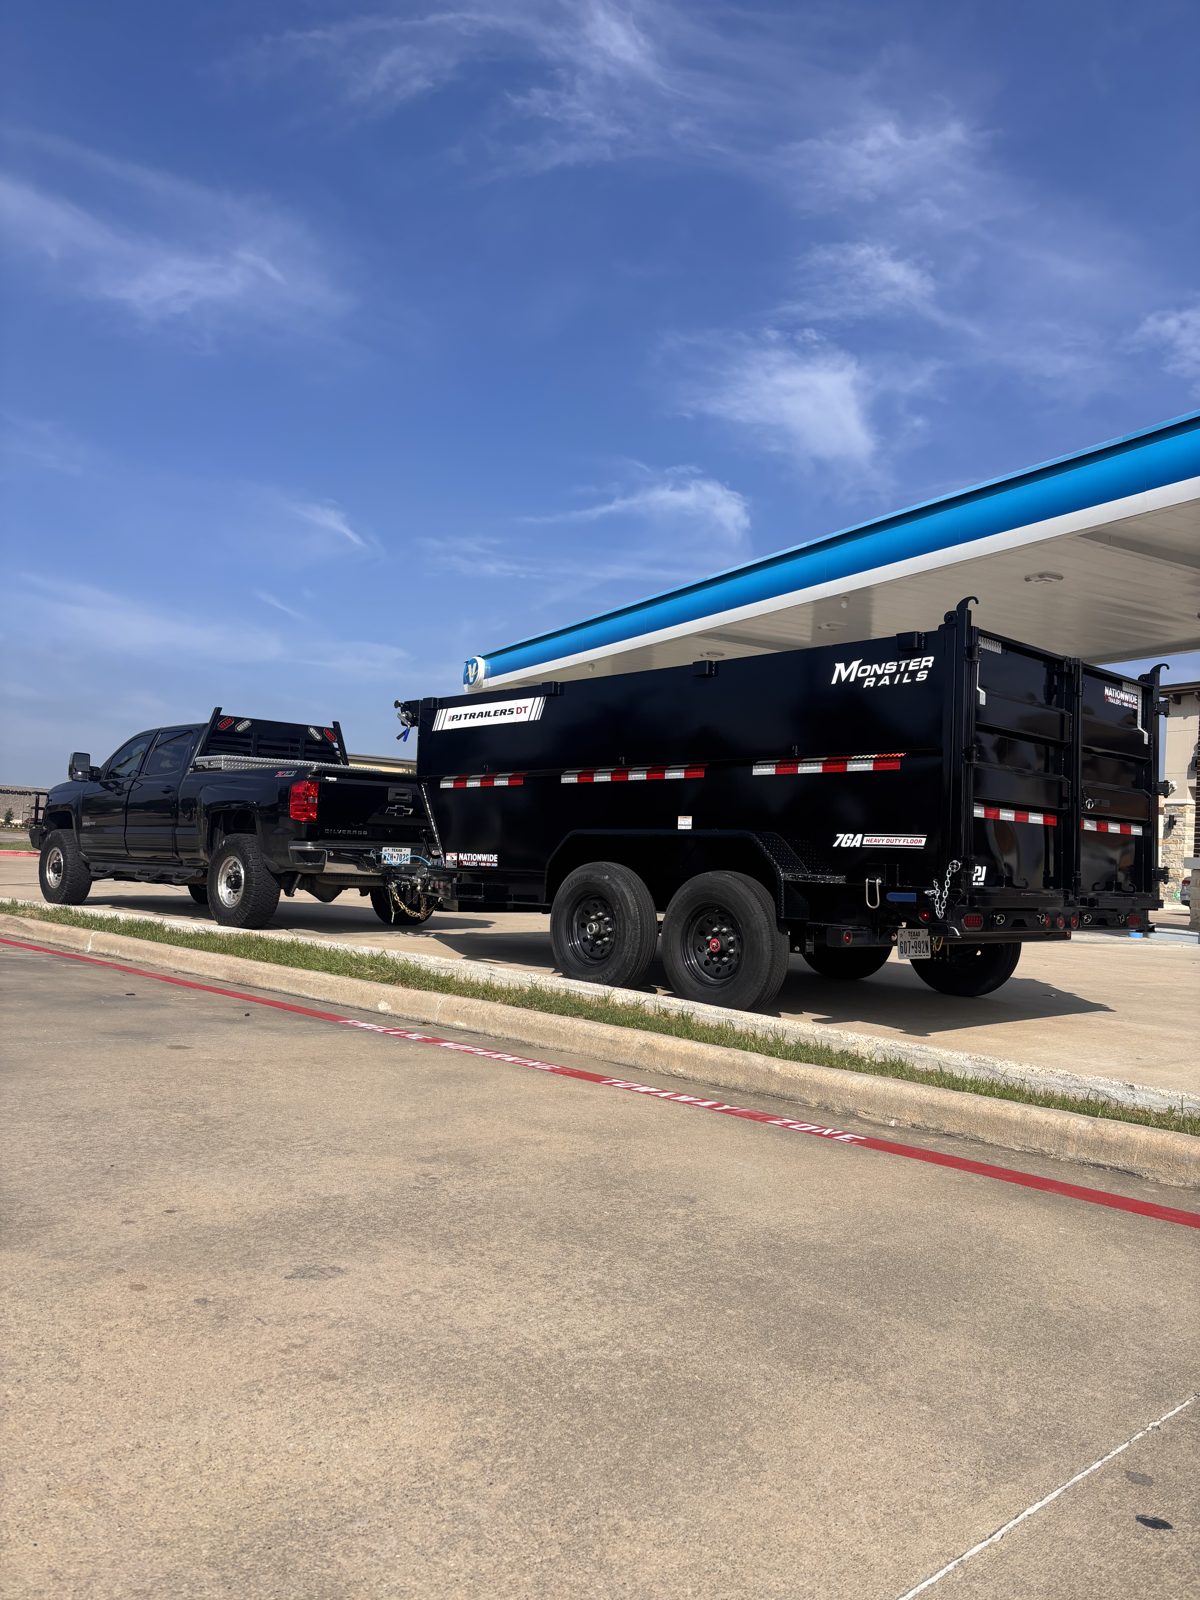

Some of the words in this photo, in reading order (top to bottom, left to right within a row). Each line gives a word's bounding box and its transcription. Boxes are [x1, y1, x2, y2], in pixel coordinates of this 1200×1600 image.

[831, 656, 935, 685] MONSTER
[863, 670, 929, 689] RAILS
[1104, 686, 1138, 704] NATIONWIDE
[515, 705, 529, 715] DT
[832, 833, 863, 848] 7GA
[459, 852, 498, 862] NATIONWIDE
[768, 1118, 867, 1144] ZONE
